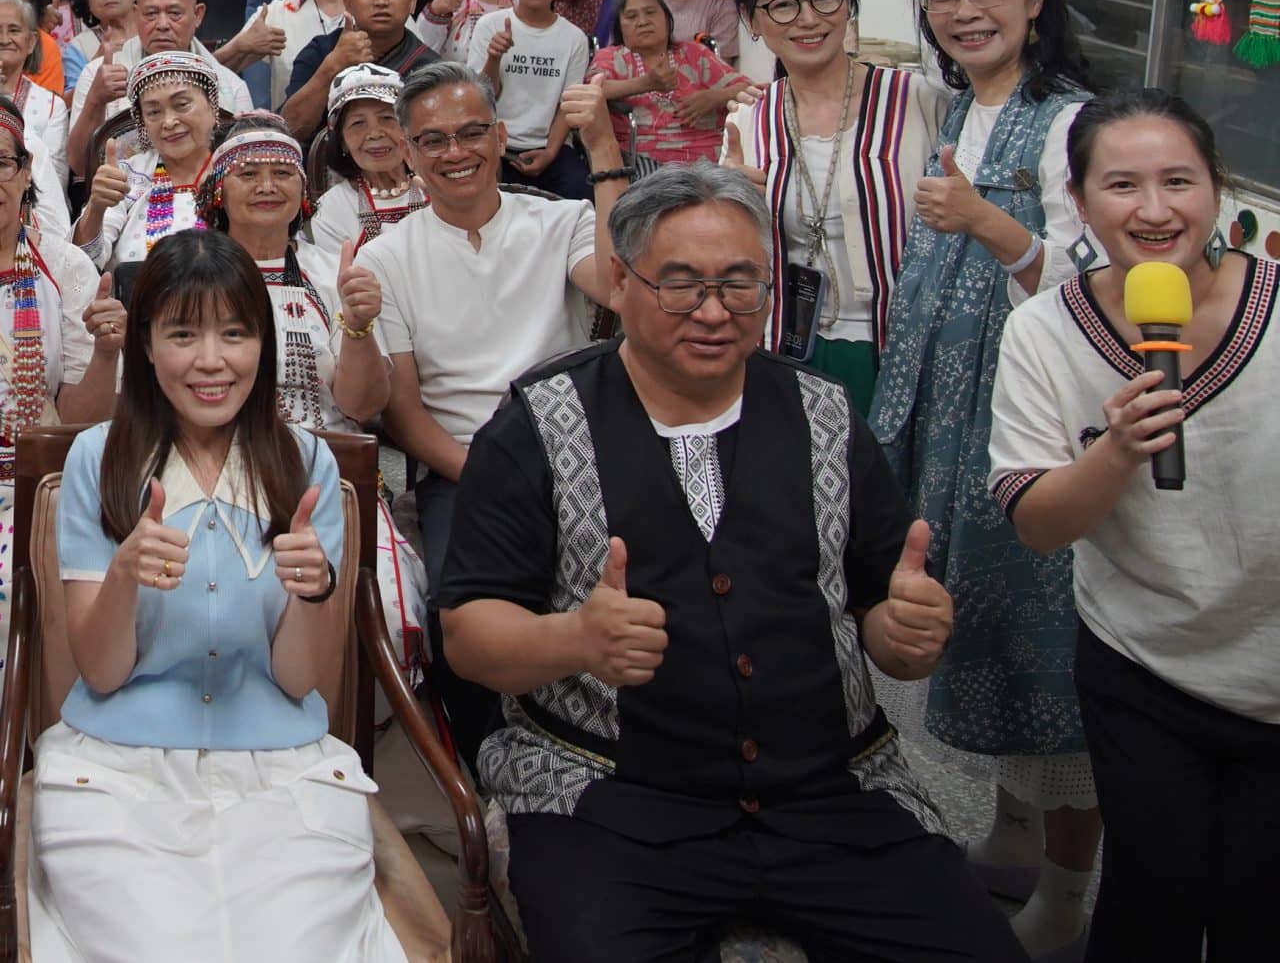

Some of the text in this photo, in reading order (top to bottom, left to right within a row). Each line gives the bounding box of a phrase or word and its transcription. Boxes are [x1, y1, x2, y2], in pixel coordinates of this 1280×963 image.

[513, 55, 554, 66] NO TEXT
[505, 65, 560, 77] JUST VIBES
